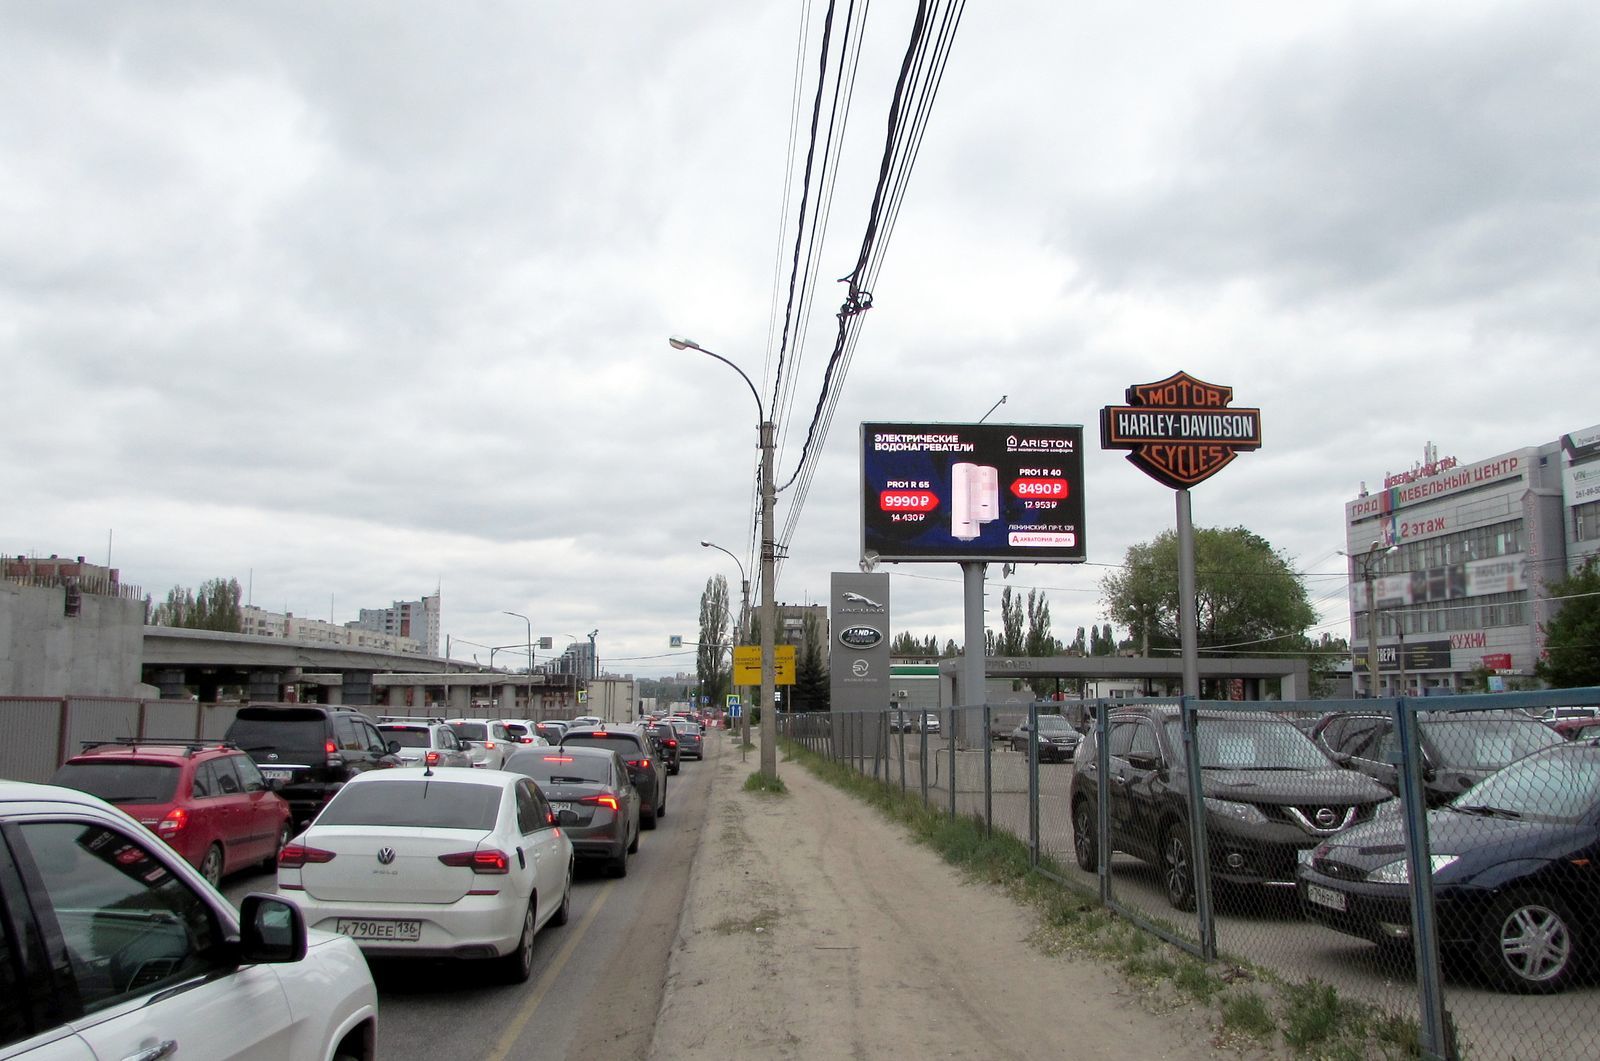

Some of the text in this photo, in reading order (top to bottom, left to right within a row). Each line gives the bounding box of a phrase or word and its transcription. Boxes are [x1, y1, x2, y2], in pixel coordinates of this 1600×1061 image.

[1150, 379, 1220, 406] MOTOR
[1119, 413, 1253, 438] HARLEY-DAVIDSON
[874, 434, 958, 443] ЭЛЕКТРИЧЕСКИЕ
[1020, 440, 1073, 448] ARISTON
[874, 443, 974, 452] ВОДОНАГРЕВАТЕЛИ
[1151, 445, 1223, 478] CYCLES
[1399, 457, 1518, 503] МЕБЕЛЬНЫЙ ЦЕНТР
[1352, 499, 1378, 517] ГРАД
[1401, 517, 1445, 538] 2 этаж
[1450, 632, 1486, 649] КУХНИ
[986, 660, 1031, 670] PPROVED
[396, 922, 416, 934] 136
